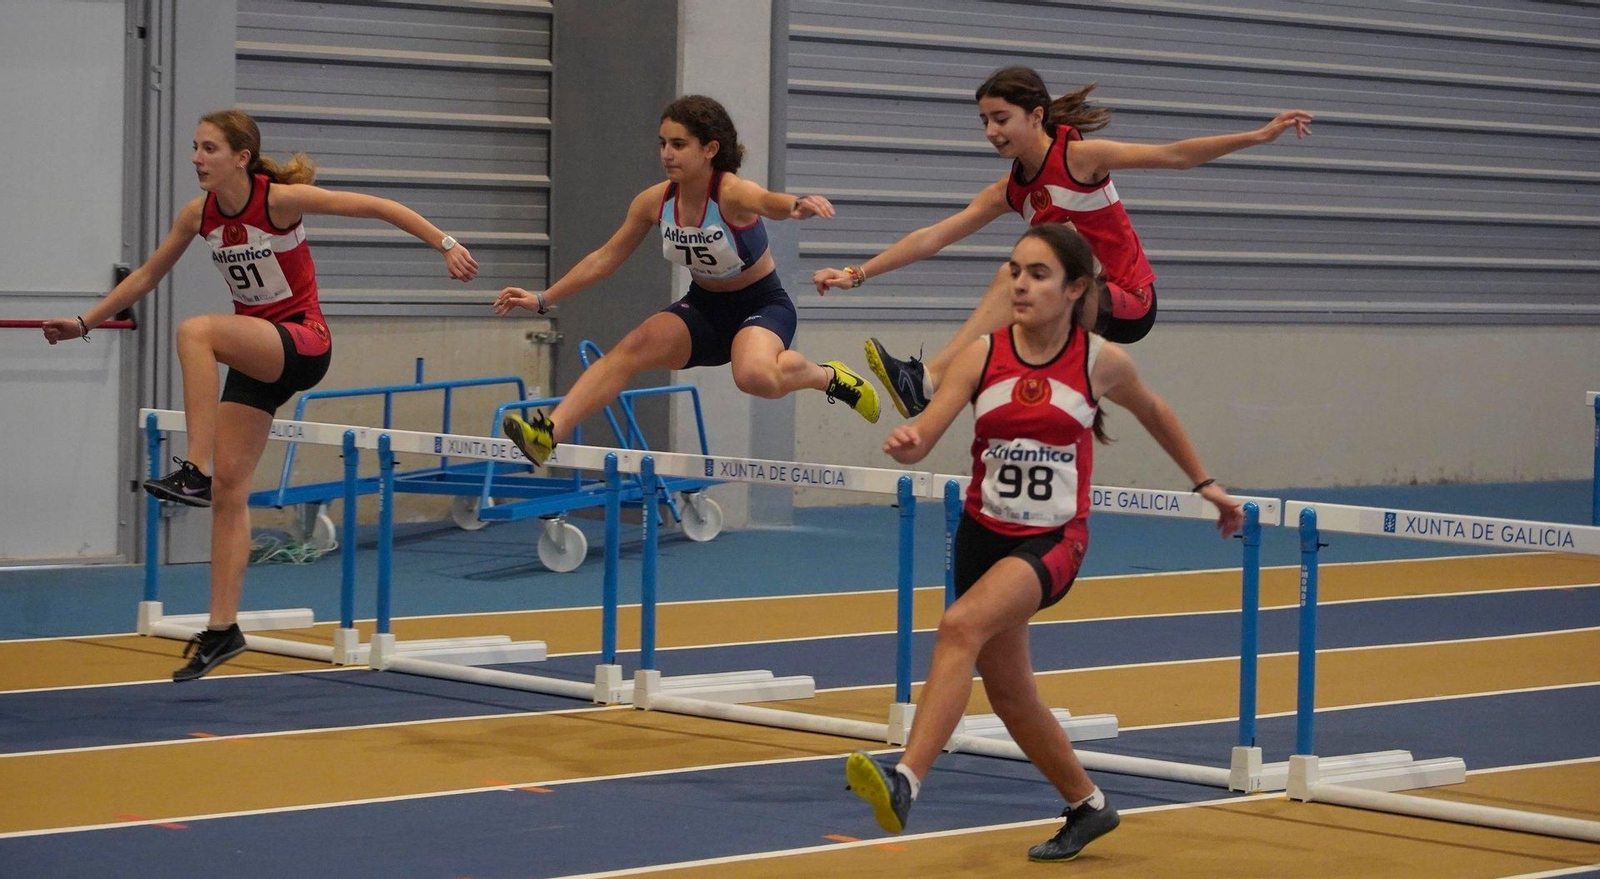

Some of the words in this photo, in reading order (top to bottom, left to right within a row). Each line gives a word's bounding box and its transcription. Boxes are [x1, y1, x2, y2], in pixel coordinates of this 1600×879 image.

[664, 226, 723, 244] Atlántico
[212, 246, 272, 264] Atlántico
[675, 244, 718, 266] 75
[228, 263, 264, 290] 91
[270, 424, 305, 439] ALICIA
[448, 439, 488, 456] XUNTA
[491, 443, 507, 459] DE
[720, 461, 765, 479] XUNTA
[770, 466, 787, 481] DE
[791, 467, 846, 486] GALICIA
[998, 464, 1054, 501] 98
[1093, 490, 1112, 507] DE
[1117, 492, 1180, 512] GALICIA
[1405, 516, 1466, 538] XUNTA
[1472, 522, 1495, 541] DE
[1501, 525, 1575, 548] GALICIA
